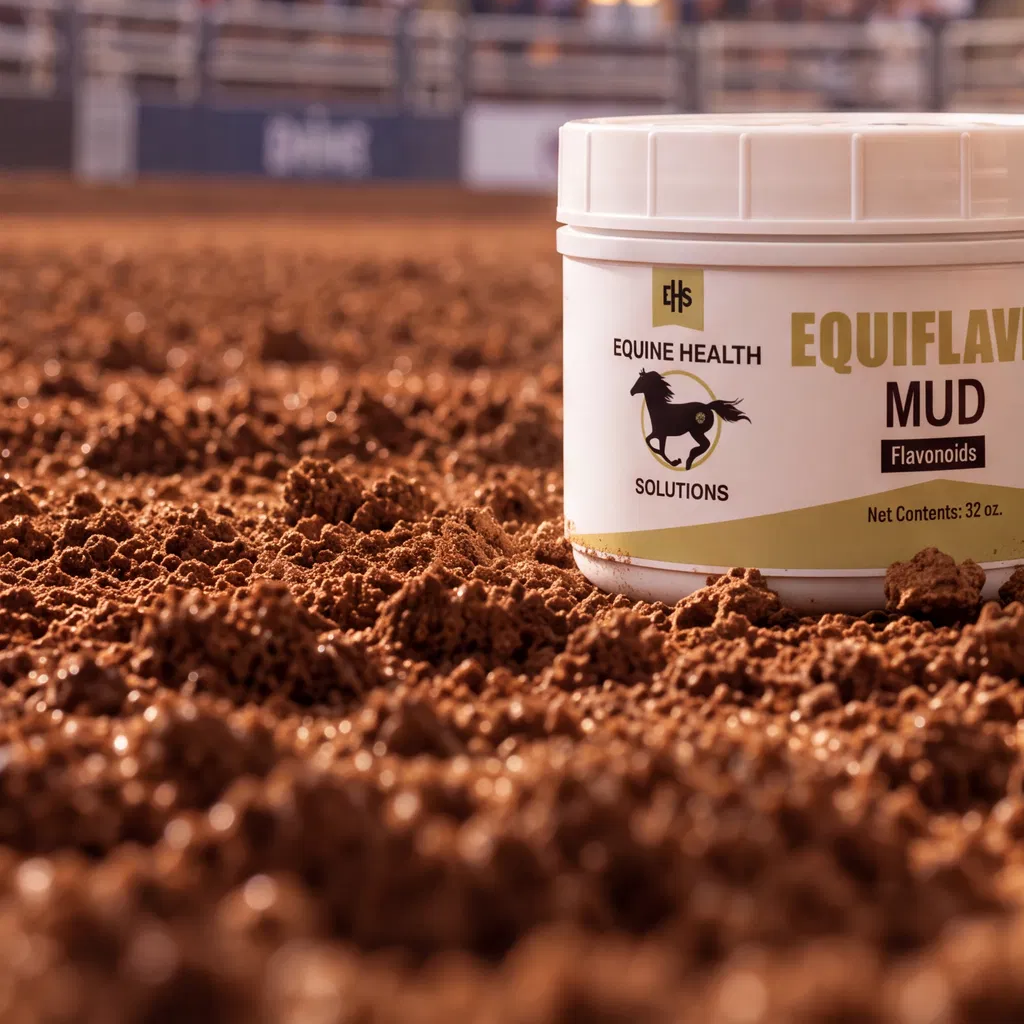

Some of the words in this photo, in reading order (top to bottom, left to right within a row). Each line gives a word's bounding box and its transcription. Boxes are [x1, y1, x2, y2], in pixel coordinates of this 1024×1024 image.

[613, 338, 674, 362] EQUINE
[679, 343, 762, 366] HEALTH
[885, 378, 985, 428] MUD
[891, 443, 977, 467] Flavonoids
[635, 477, 729, 502] SOLUTIONS
[867, 506, 892, 524] Net
[896, 504, 963, 523] Contents:
[965, 502, 980, 518] 32
[983, 504, 1003, 518] oz.
